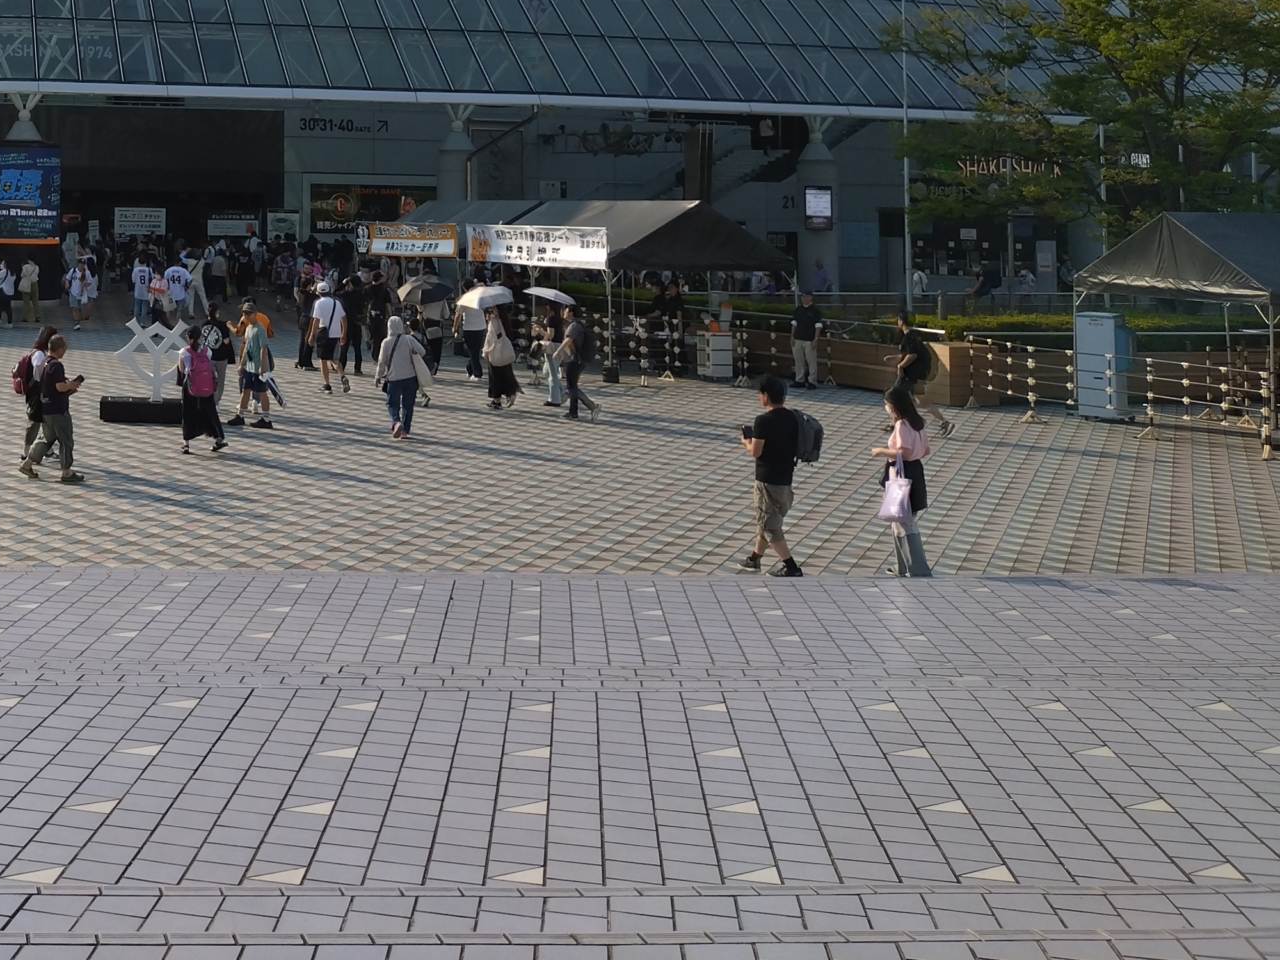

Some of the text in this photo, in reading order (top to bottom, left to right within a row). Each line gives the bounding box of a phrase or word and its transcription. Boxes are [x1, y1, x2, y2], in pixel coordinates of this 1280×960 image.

[80, 45, 114, 60] 1974
[381, 188, 401, 196] GAME
[782, 195, 795, 209] 21
[139, 275, 146, 284] 8
[170, 274, 182, 285] 44
